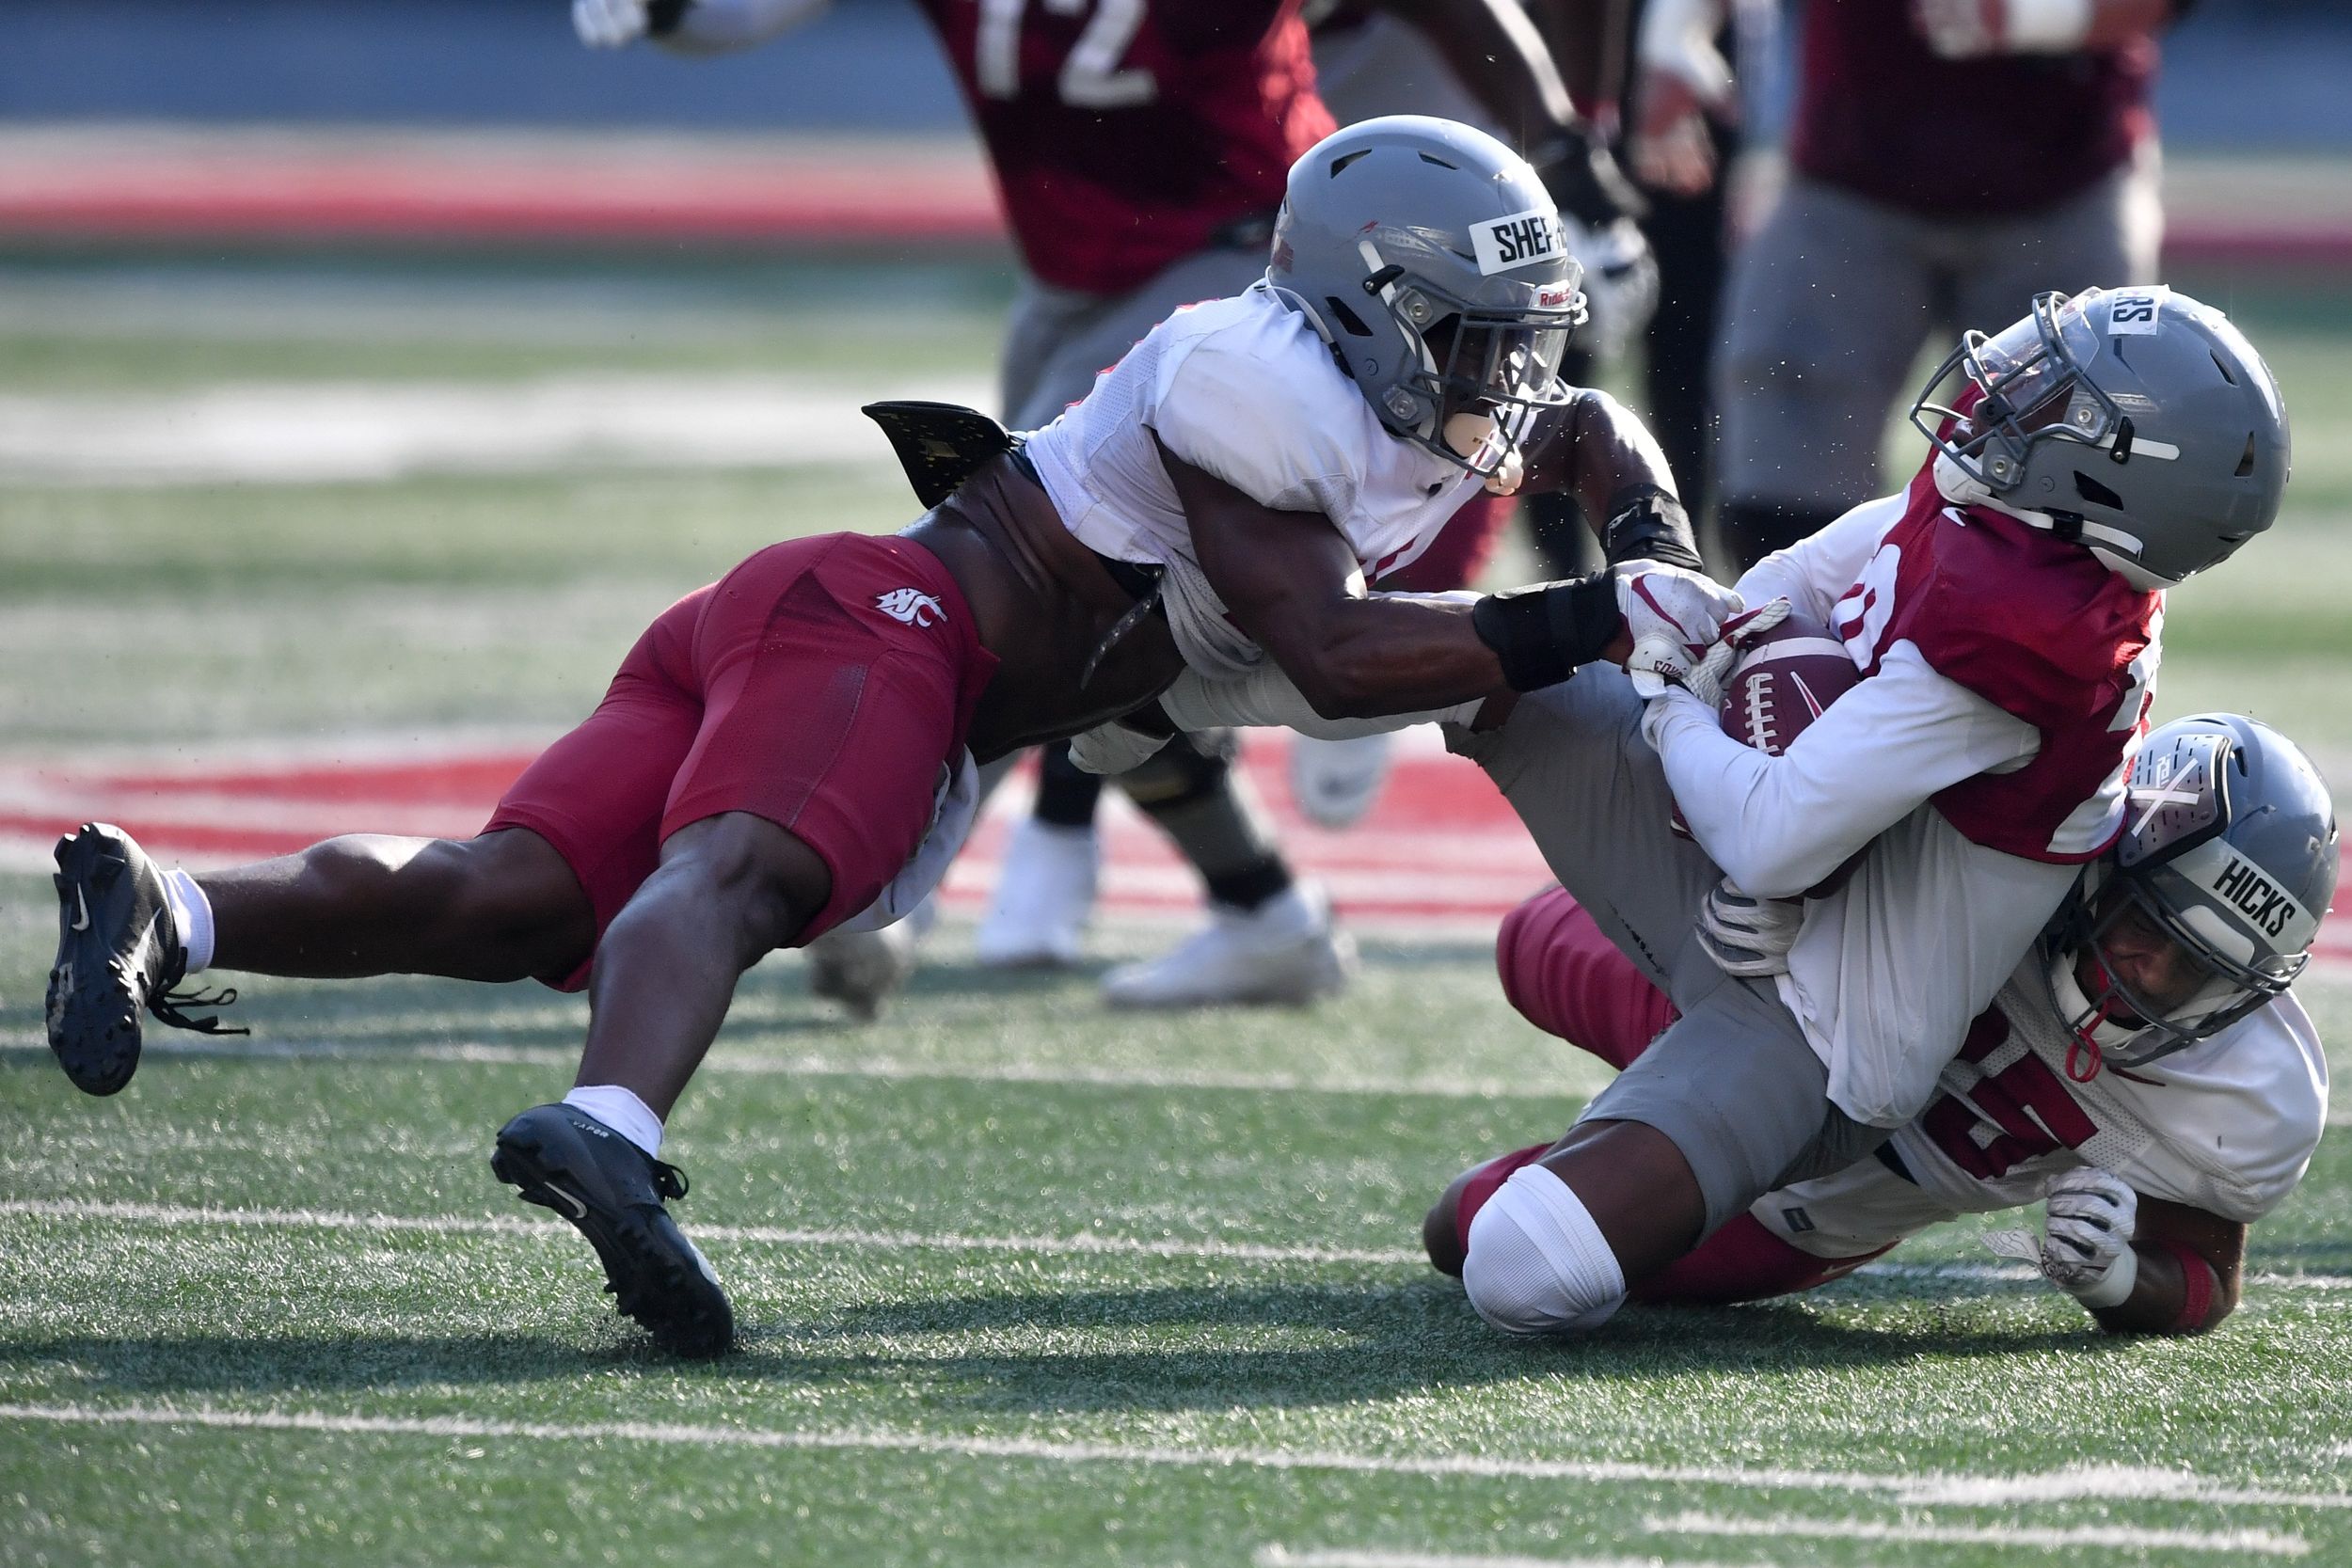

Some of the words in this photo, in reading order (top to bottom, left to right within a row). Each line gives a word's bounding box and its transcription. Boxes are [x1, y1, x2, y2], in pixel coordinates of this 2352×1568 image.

[2112, 293, 2154, 322] RS
[2213, 856, 2296, 938] HICKS
[572, 1120, 610, 1138] VAPOR
